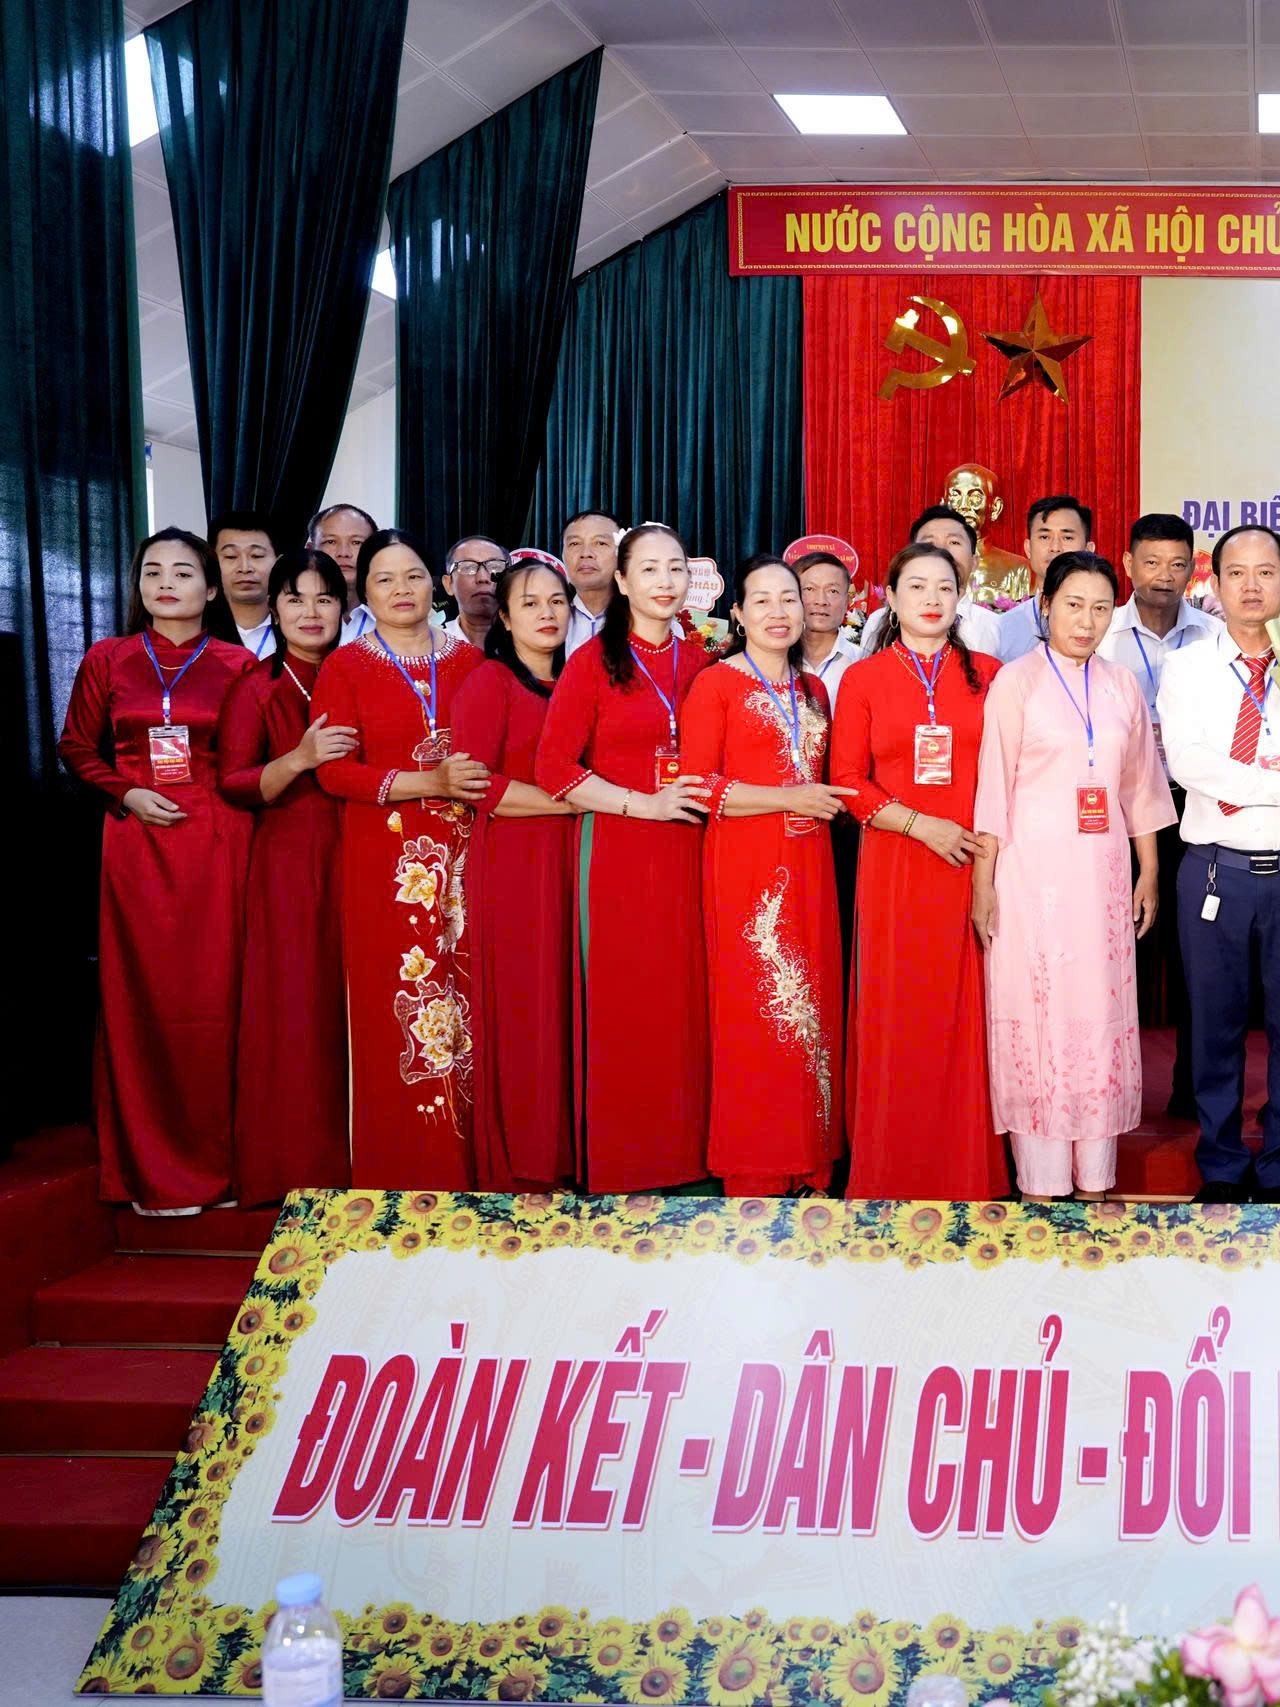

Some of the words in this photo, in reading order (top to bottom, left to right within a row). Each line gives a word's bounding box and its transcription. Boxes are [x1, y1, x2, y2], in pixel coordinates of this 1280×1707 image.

[786, 204, 881, 253] NƯỚC
[895, 204, 991, 261] CỘNG
[1004, 203, 1075, 253] HÒA
[1086, 205, 1134, 253] XÃ
[1146, 205, 1204, 262] HỘI
[1183, 500, 1230, 538] ĐẠI
[272, 1322, 528, 1524] ĐOÀN
[512, 1309, 687, 1527] KẾT
[713, 1330, 895, 1533] DÂN
[908, 1314, 1069, 1537] CHỦ
[1122, 1306, 1252, 1538] ĐỔI
